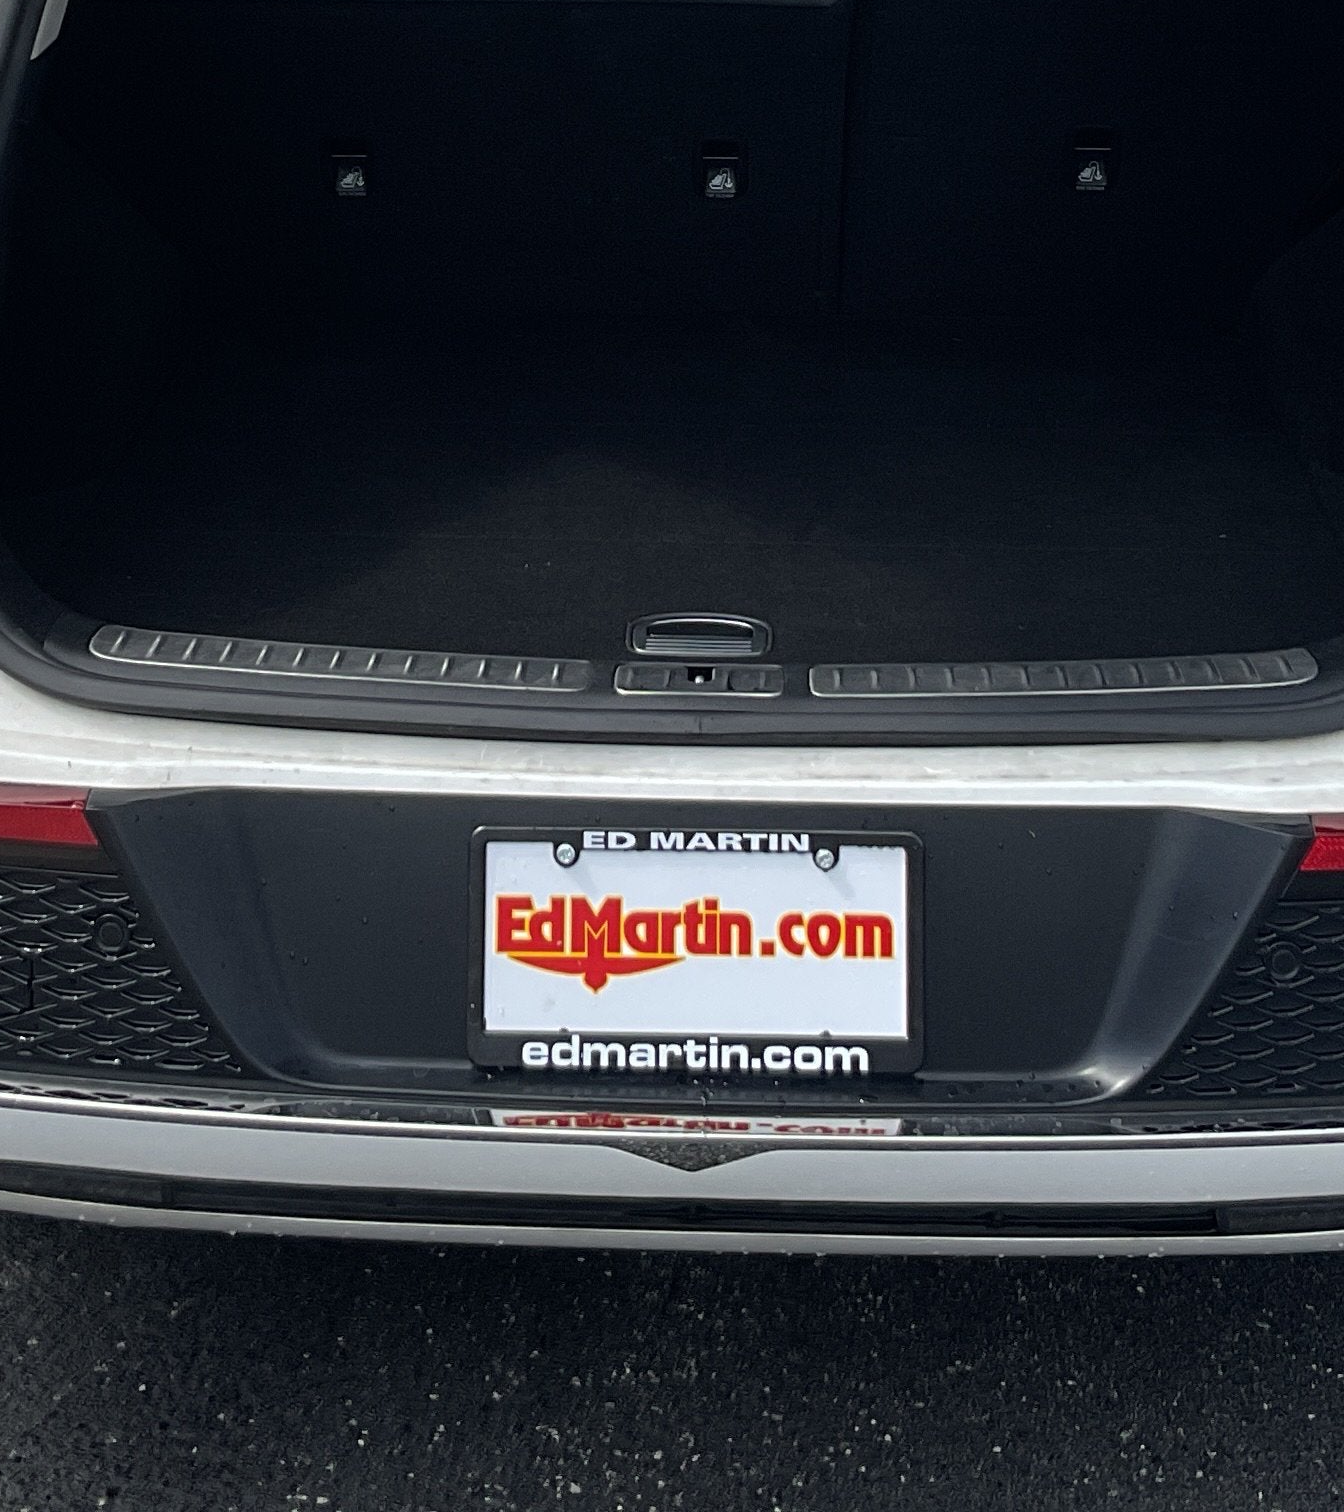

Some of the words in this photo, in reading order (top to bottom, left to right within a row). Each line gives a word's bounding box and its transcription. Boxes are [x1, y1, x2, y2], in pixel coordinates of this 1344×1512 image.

[582, 830, 636, 849] ED
[649, 832, 810, 852] MARTIN
[495, 894, 895, 958] EdMartin.com
[521, 1034, 870, 1071] edmartin.com
